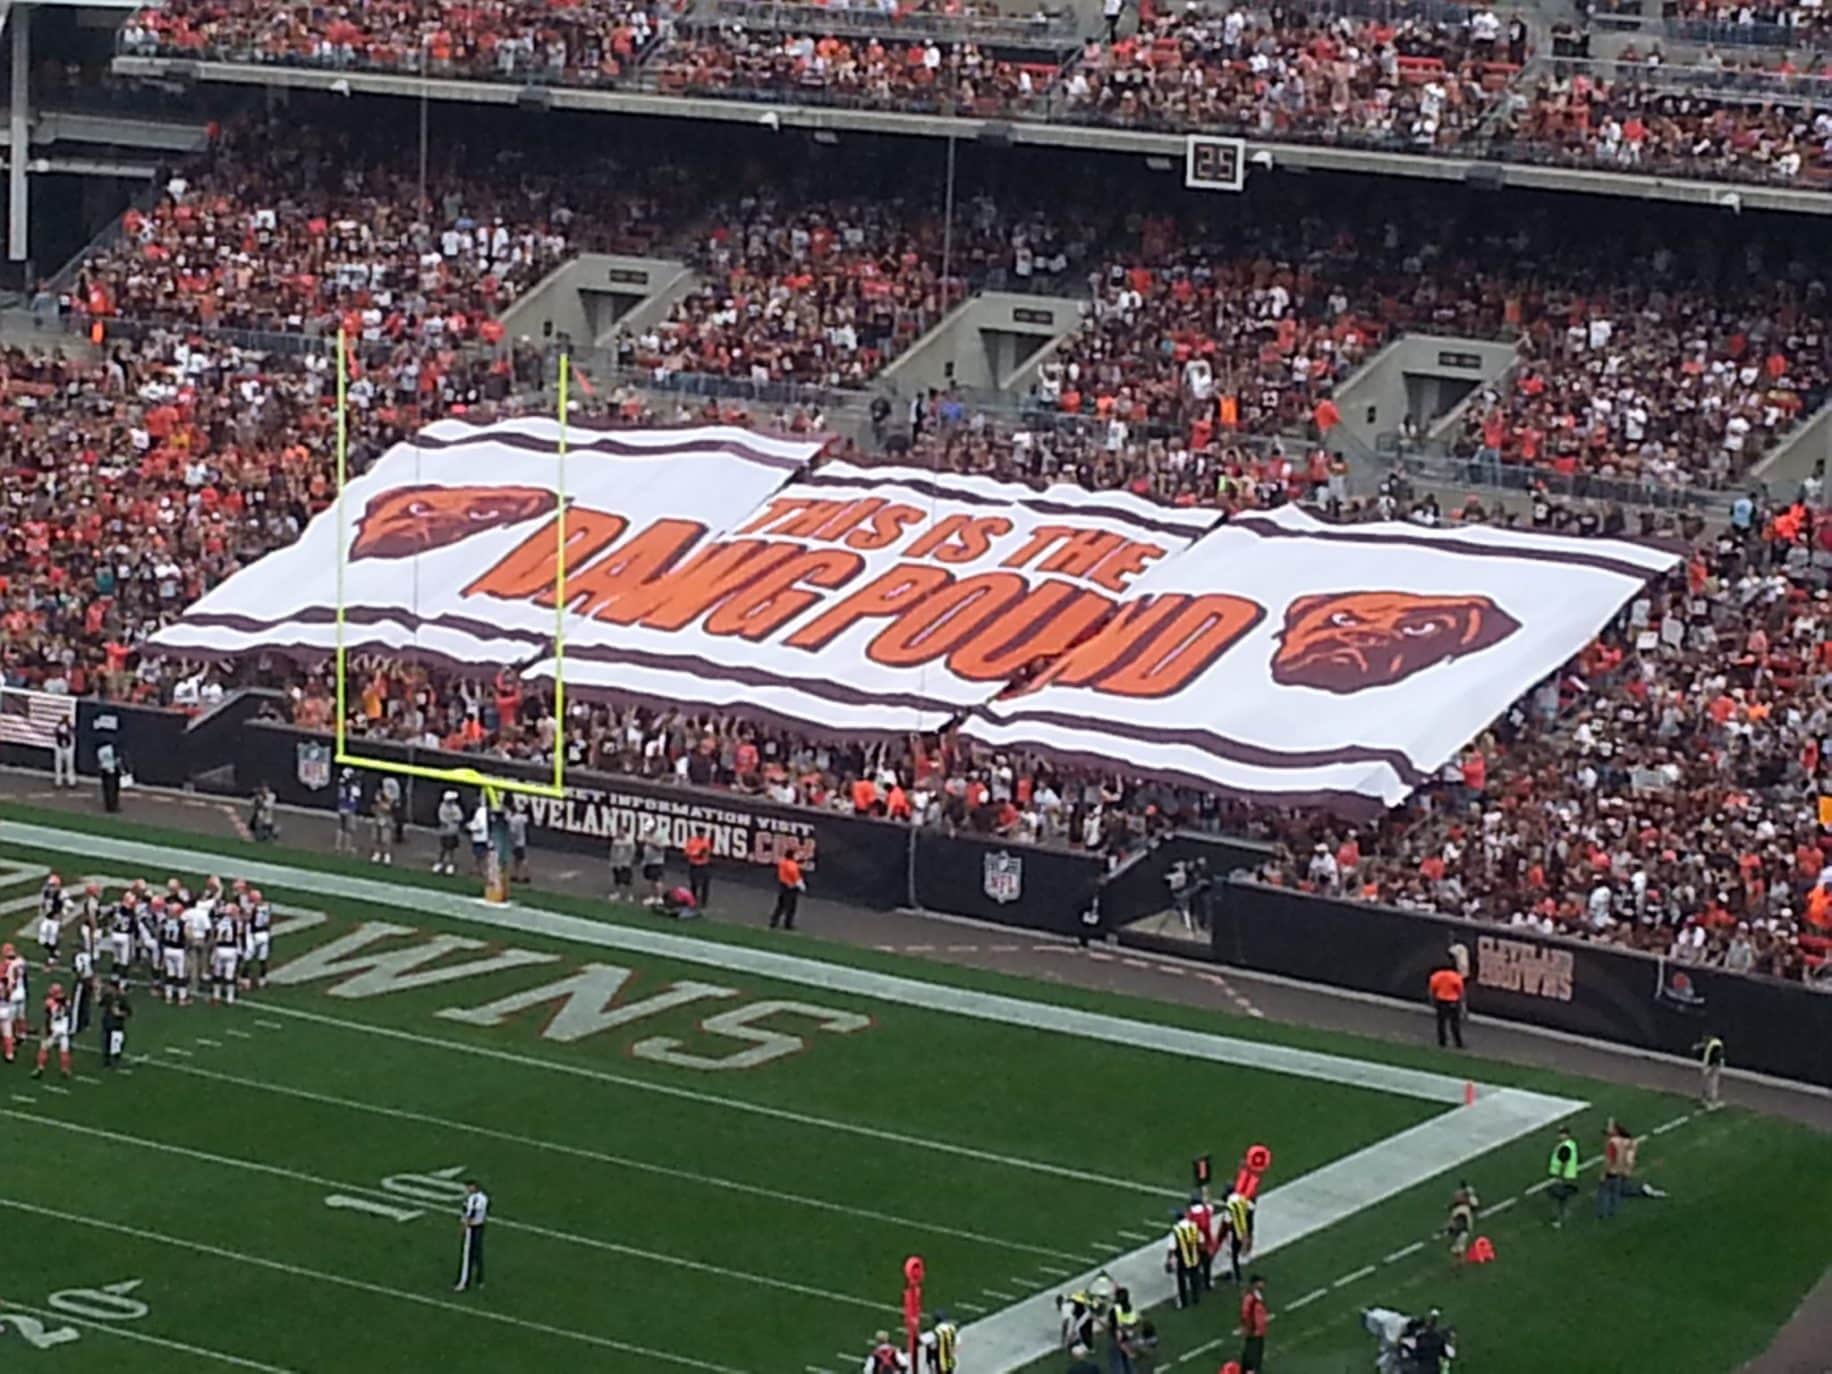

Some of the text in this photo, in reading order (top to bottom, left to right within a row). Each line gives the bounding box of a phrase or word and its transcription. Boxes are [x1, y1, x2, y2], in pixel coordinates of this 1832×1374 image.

[734, 497, 1168, 593] THIS IS THE
[459, 505, 1268, 700] DAWG POUND
[609, 792, 752, 824] INFORMATION
[756, 815, 815, 836] VISIT
[324, 1172, 469, 1222] 10
[0, 1288, 149, 1349] 20
